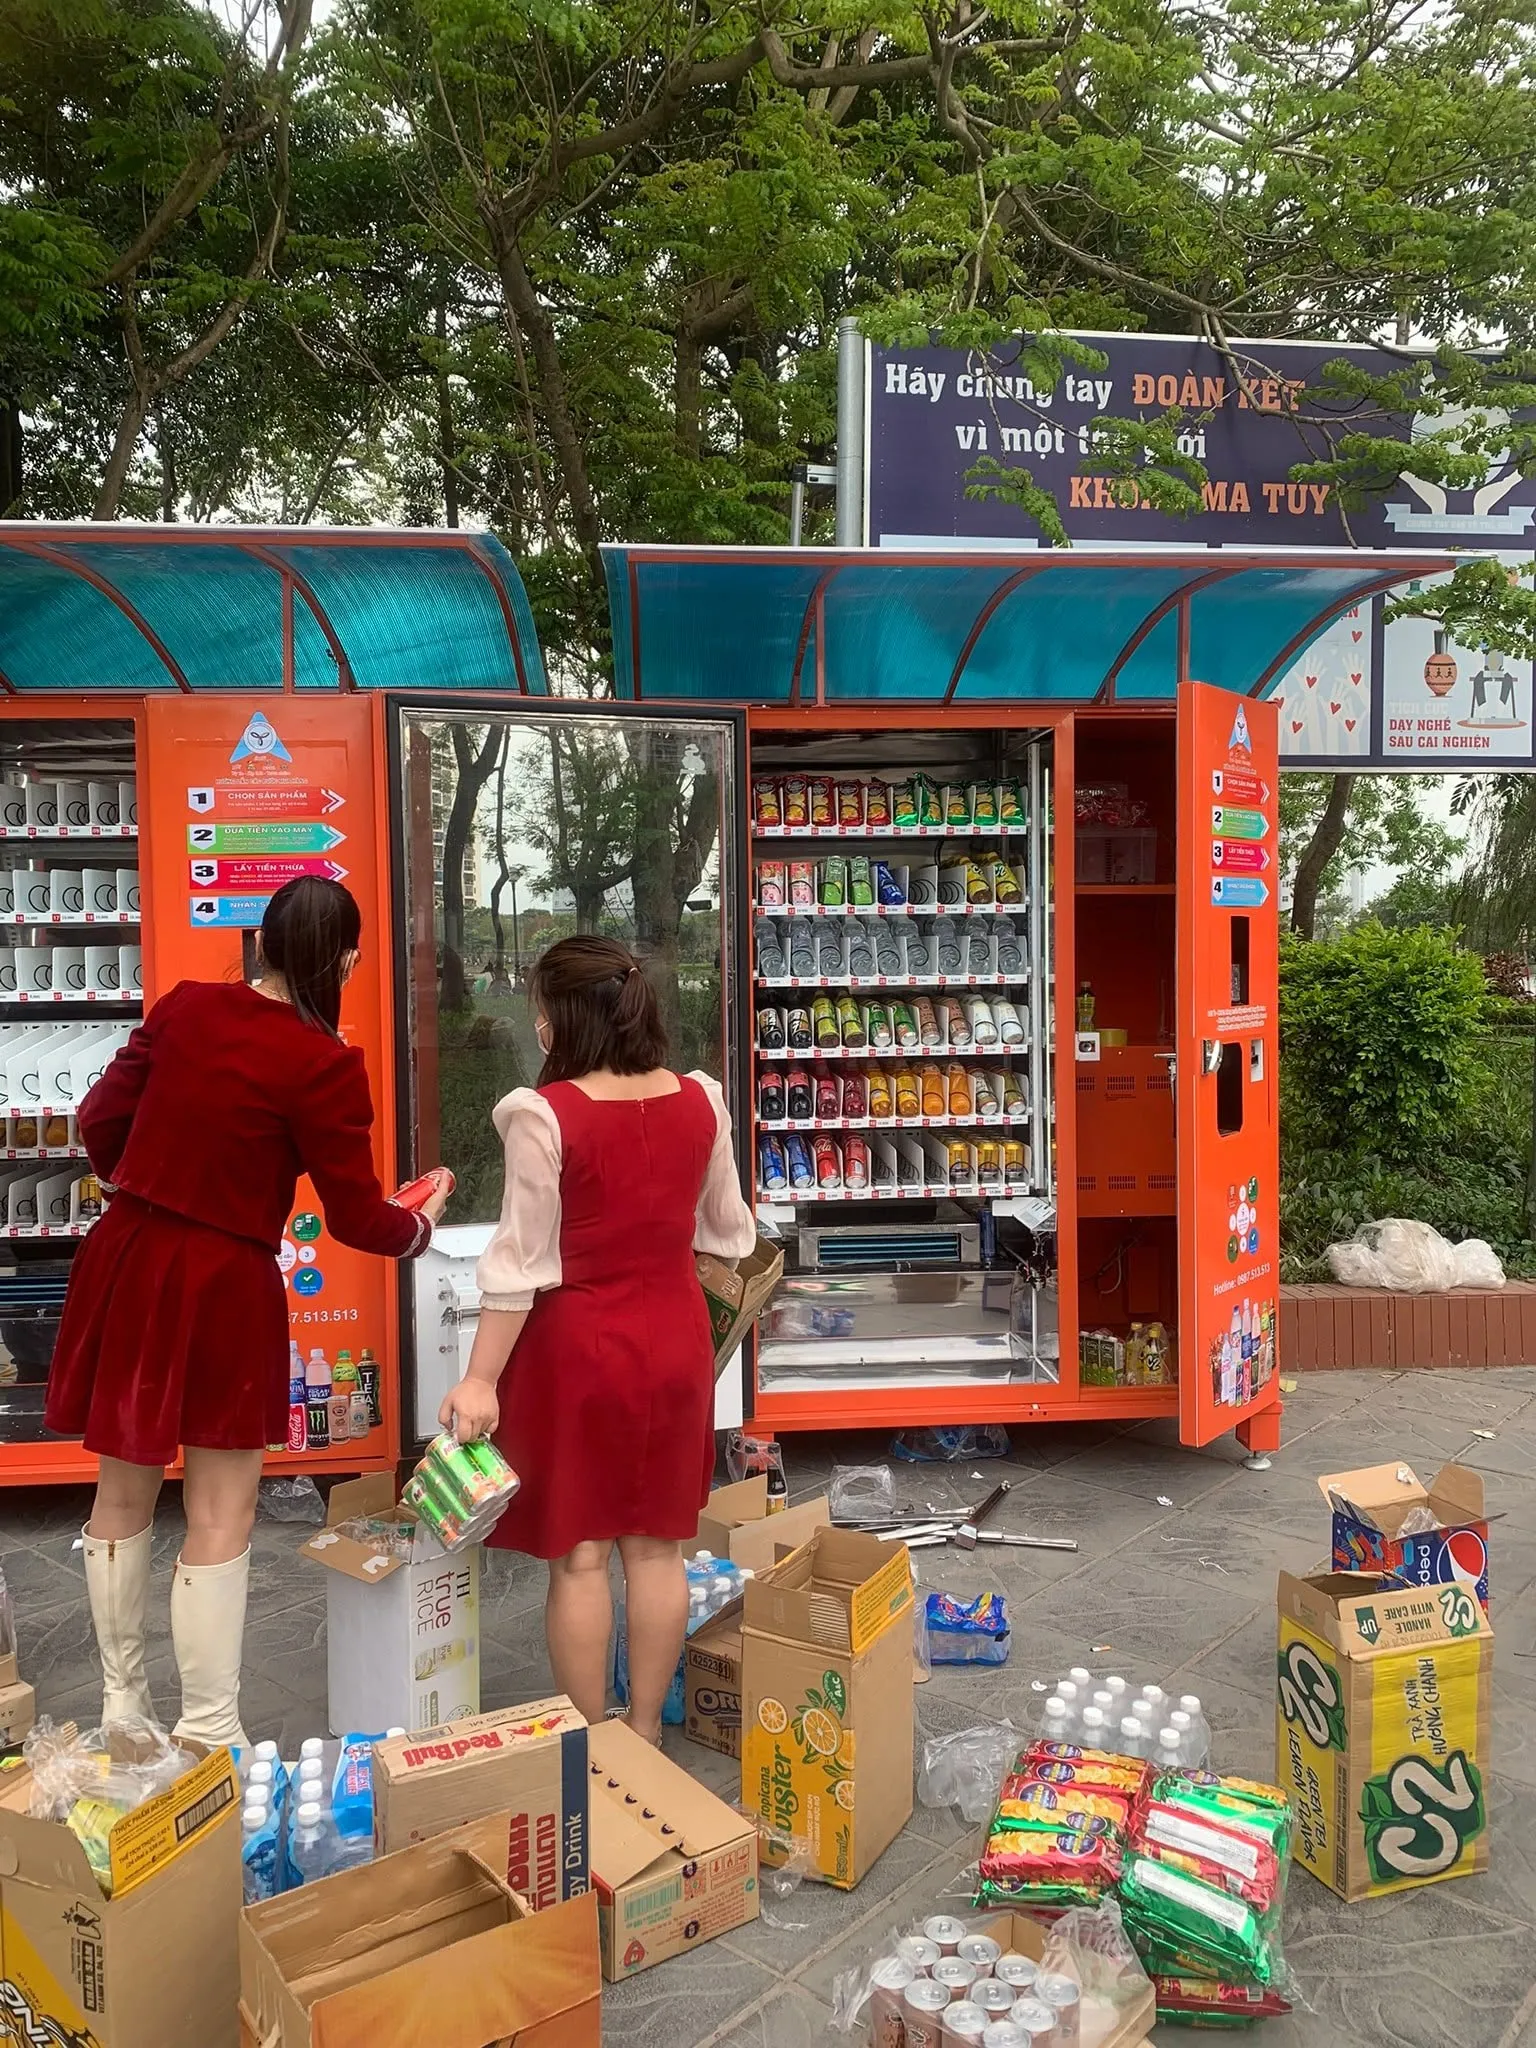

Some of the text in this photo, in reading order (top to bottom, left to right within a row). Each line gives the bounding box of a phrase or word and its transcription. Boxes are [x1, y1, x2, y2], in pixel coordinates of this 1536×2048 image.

[886, 363, 946, 403] Hãy
[1065, 374, 1113, 410] tay
[1131, 369, 1225, 408] ĐOÀN
[955, 419, 988, 451] vì
[1002, 422, 1066, 460] một
[1203, 481, 1251, 513] MA
[1389, 736, 1416, 749] SAU
[1418, 736, 1439, 749] CAI
[1214, 775, 1221, 787] 1
[192, 792, 208, 805] 1
[1214, 811, 1222, 823] 2
[193, 829, 214, 842] 2
[1214, 846, 1222, 858] 3
[194, 865, 216, 878] 3
[1213, 881, 1222, 893] 4
[195, 901, 216, 914] 4
[288, 1308, 359, 1324] 7.513.513
[457, 1566, 472, 1599] TH
[417, 1579, 435, 1636] RICE
[435, 1570, 454, 1630] true
[1384, 1601, 1435, 1620] WITH CARE
[1440, 1589, 1476, 1630] C2
[1361, 1616, 1379, 1634] UP
[1395, 1618, 1432, 1634] HANDLE
[1279, 1643, 1338, 1747] C2
[1418, 1657, 1441, 1704] CHANH
[695, 1687, 742, 1716] OR
[1404, 1678, 1426, 1743] TRÀ XANH
[759, 1766, 771, 1824] ropicana
[1287, 1726, 1318, 1865] LEMON FLAVOR
[1306, 1765, 1328, 1850] GREEN TEA
[1377, 1755, 1476, 1878] C2
[564, 1812, 582, 1870] Drink
